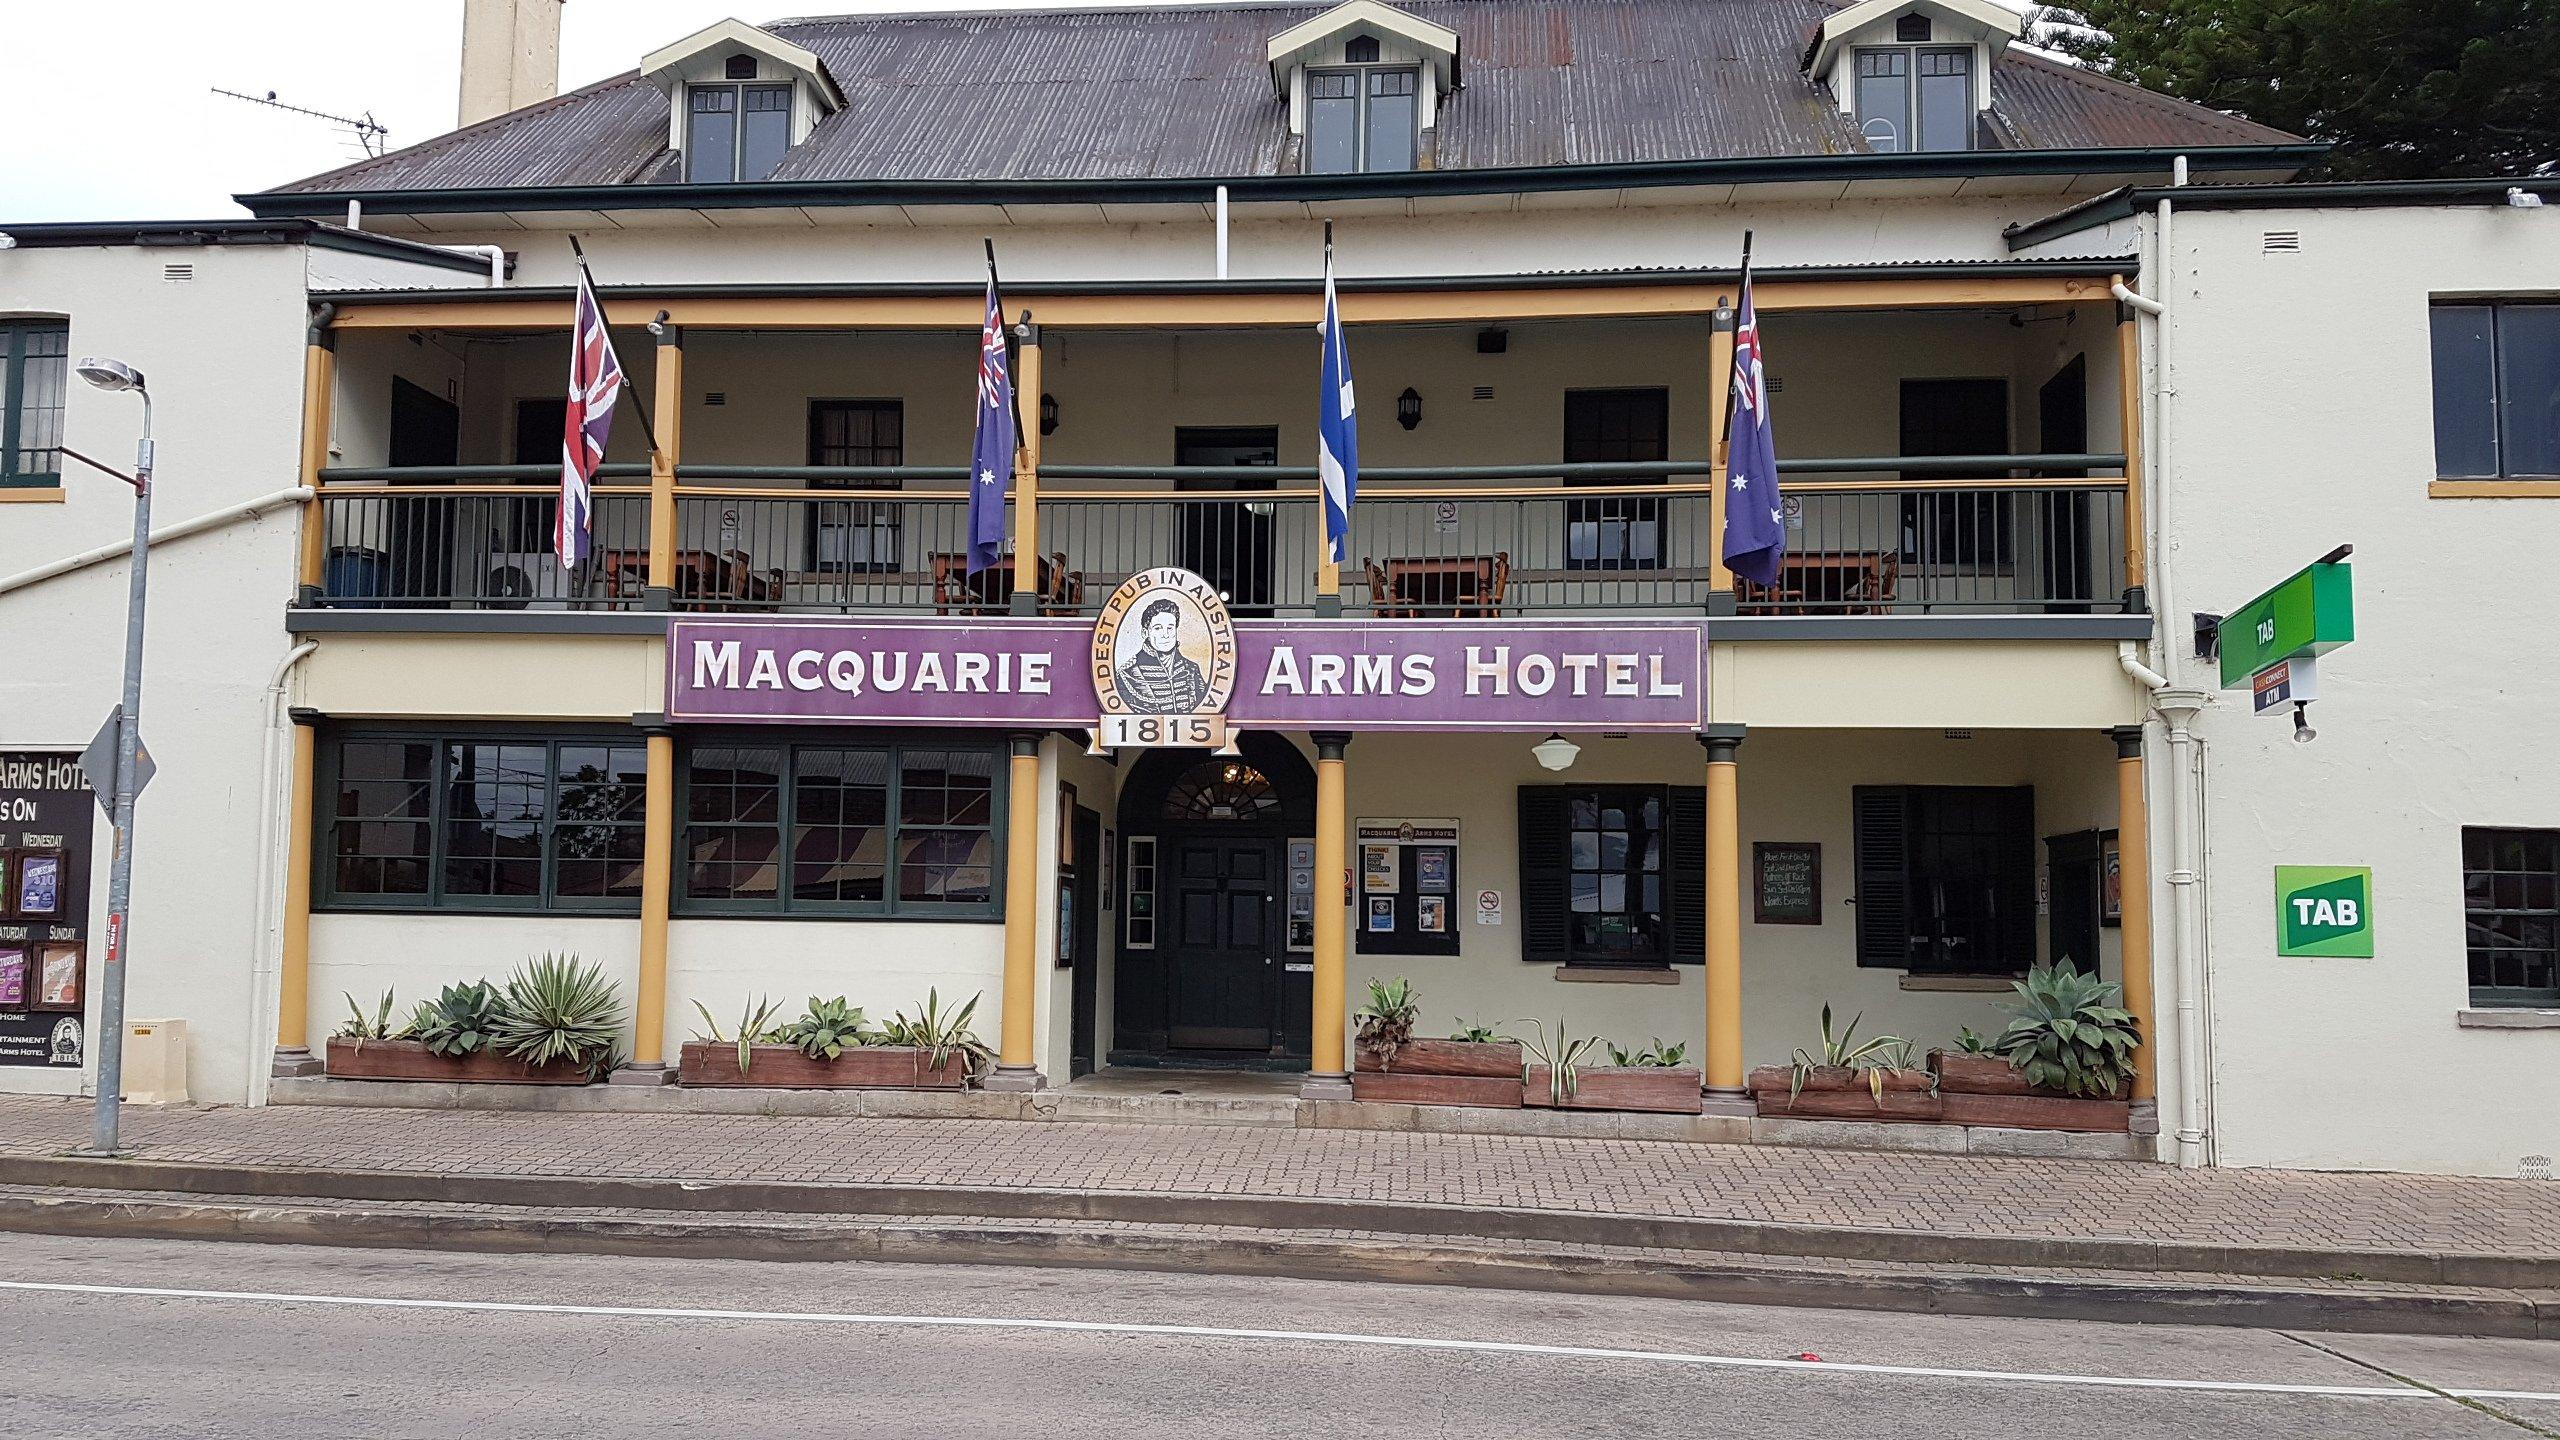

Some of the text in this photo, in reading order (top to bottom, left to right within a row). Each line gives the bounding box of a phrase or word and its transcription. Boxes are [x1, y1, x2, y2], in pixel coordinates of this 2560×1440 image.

[1095, 570, 1232, 710] OLDEST PUB IN AUSTRALIA
[2256, 618, 2275, 646] TAB
[691, 640, 1683, 698] MACQUARIE ARMS HOTEL
[2265, 686, 2280, 706] ATM
[1118, 718, 1212, 743] 1815
[46, 757, 91, 790] HOTE
[22, 832, 63, 847] WEDNESDAY
[2292, 898, 2359, 926] TAB
[49, 925, 76, 940] SUNDAY
[1, 1013, 26, 1021] HOME
[20, 1048, 45, 1056] HOTEL
